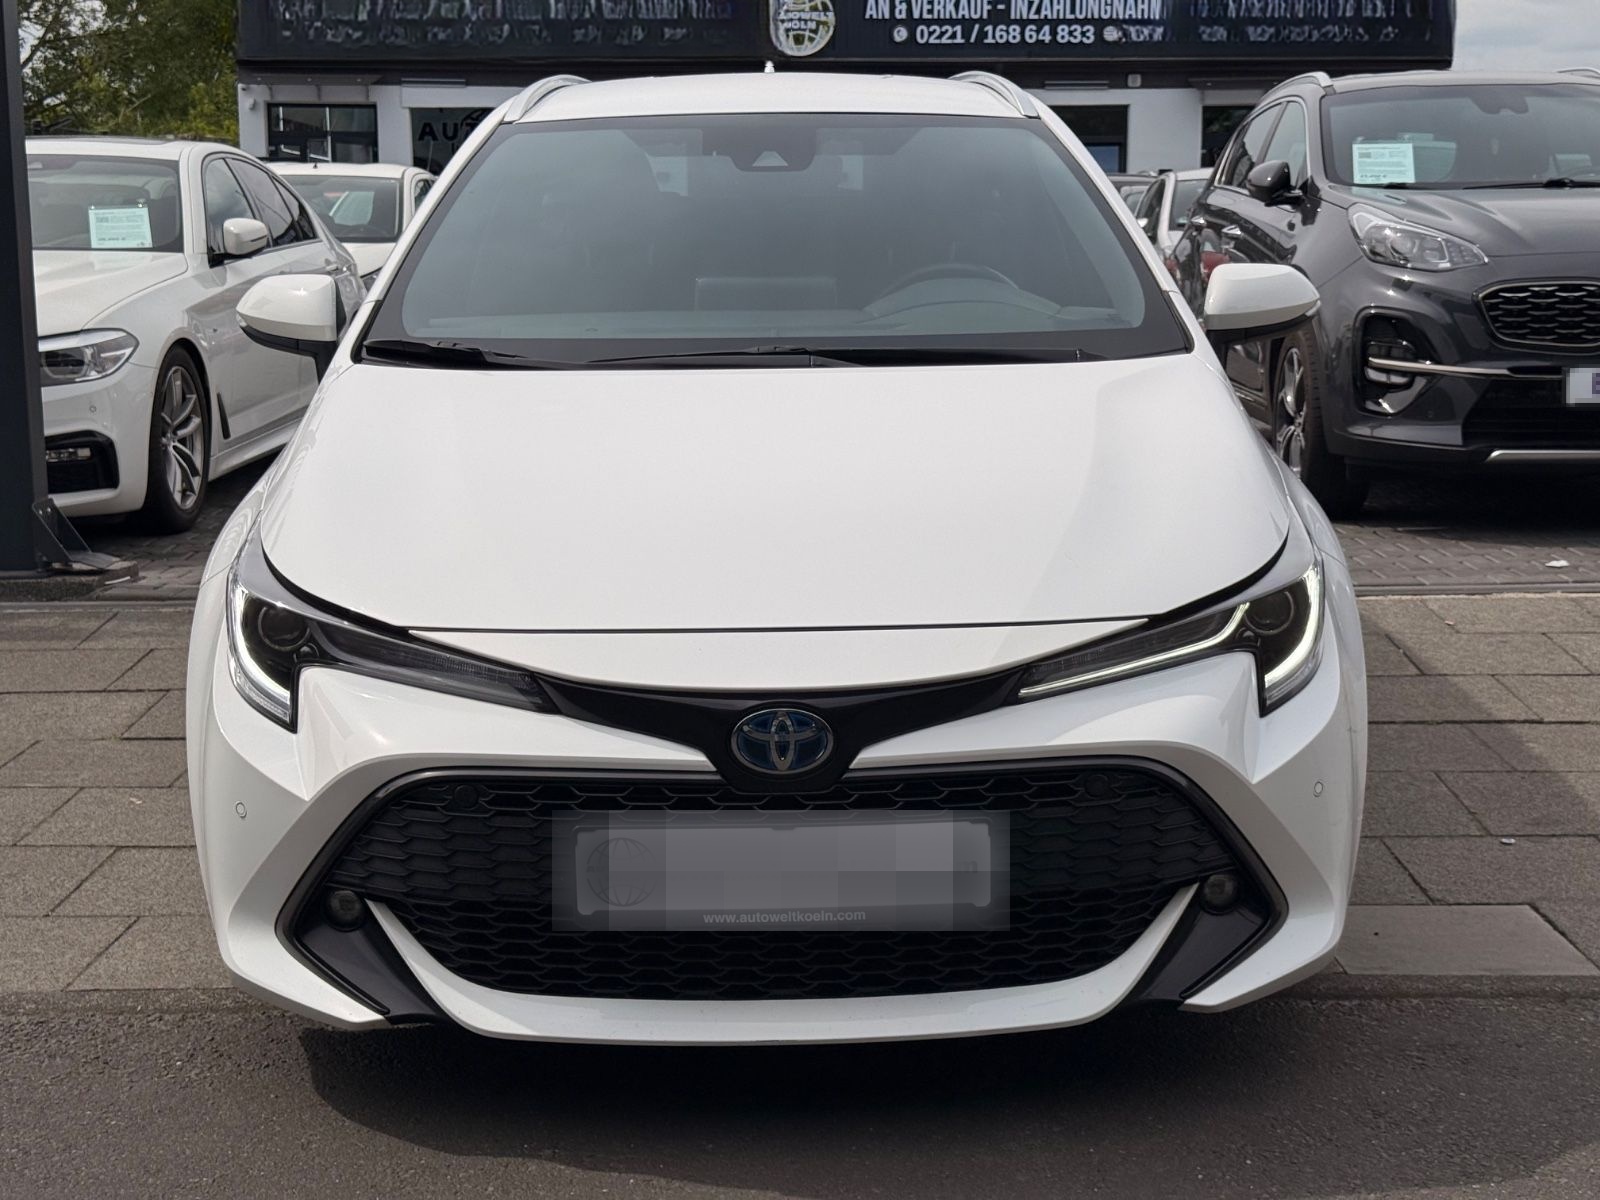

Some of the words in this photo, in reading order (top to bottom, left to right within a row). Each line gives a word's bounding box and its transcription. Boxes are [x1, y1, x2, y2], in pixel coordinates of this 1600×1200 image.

[865, 0, 890, 19] AN
[911, 0, 992, 19] VERKAUF
[916, 25, 965, 44] 0221
[969, 23, 980, 43] /
[983, 25, 1021, 44] 168
[1024, 25, 1052, 44] 64
[1056, 24, 1095, 44] 833
[703, 911, 867, 924] www.autoweltkoeln.com
